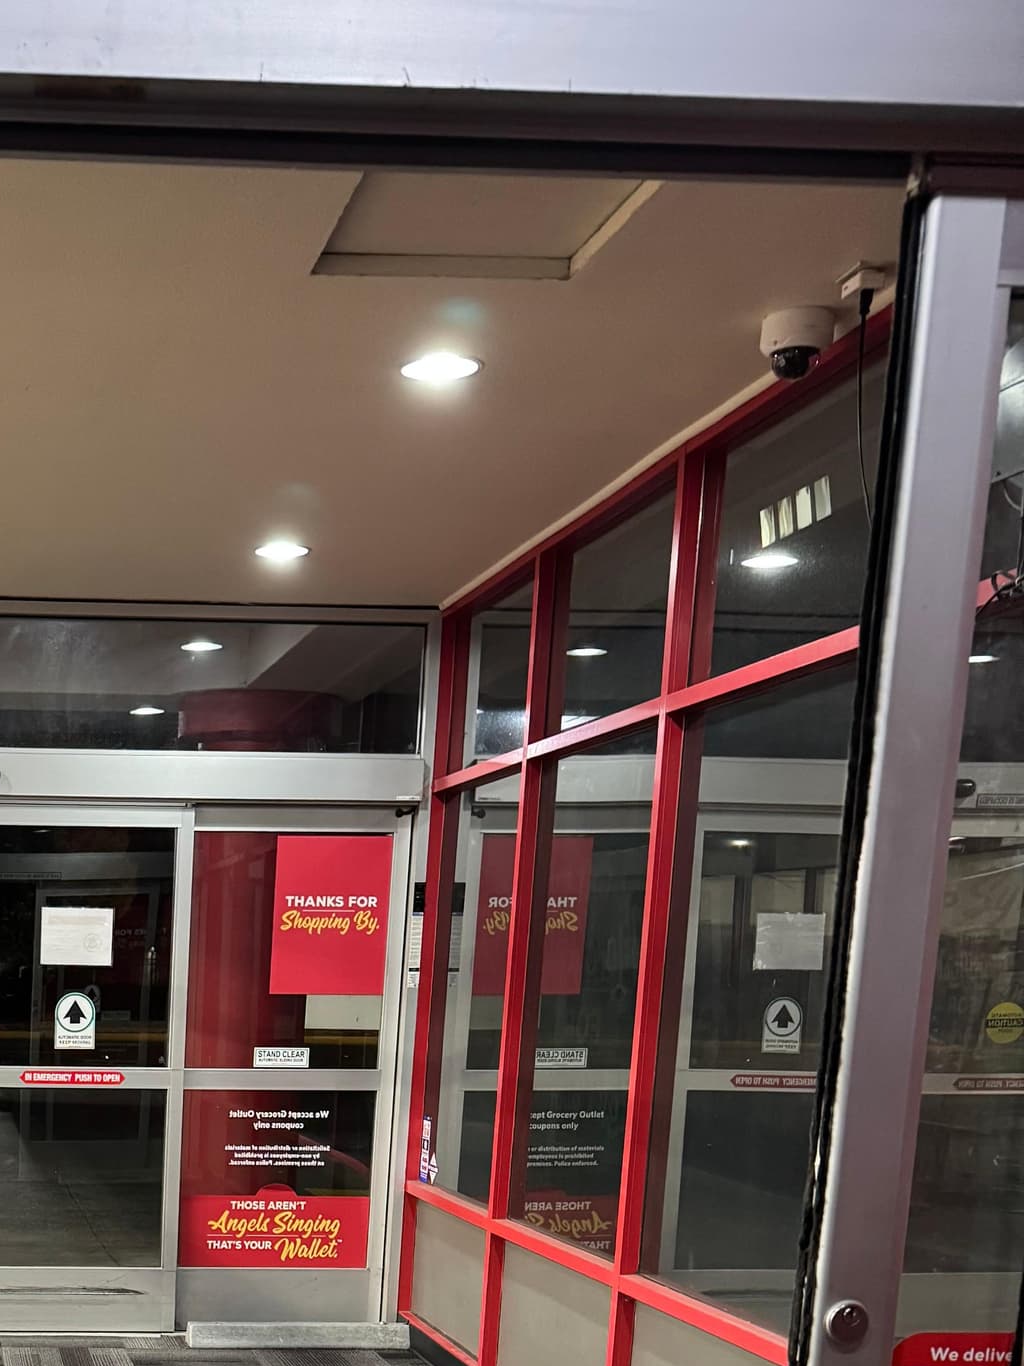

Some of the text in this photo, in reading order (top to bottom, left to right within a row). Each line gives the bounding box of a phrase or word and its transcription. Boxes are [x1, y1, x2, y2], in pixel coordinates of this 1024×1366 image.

[285, 895, 378, 908] THANKS FOR
[280, 910, 380, 935] Shopping By.
[257, 1050, 305, 1058] STAND CLEAR
[24, 1072, 120, 1082] IN EMERGENCY PUSH TO OPEN
[546, 1110, 578, 1120] Grocery
[579, 1110, 605, 1119] Outlet
[561, 1122, 579, 1131] only
[230, 1200, 306, 1211] THOSE AREN'T
[207, 1210, 340, 1239] Angels Singing
[207, 1240, 242, 1250] THAT'S
[243, 1240, 272, 1250] YOUR
[930, 1346, 1013, 1362] We delive
